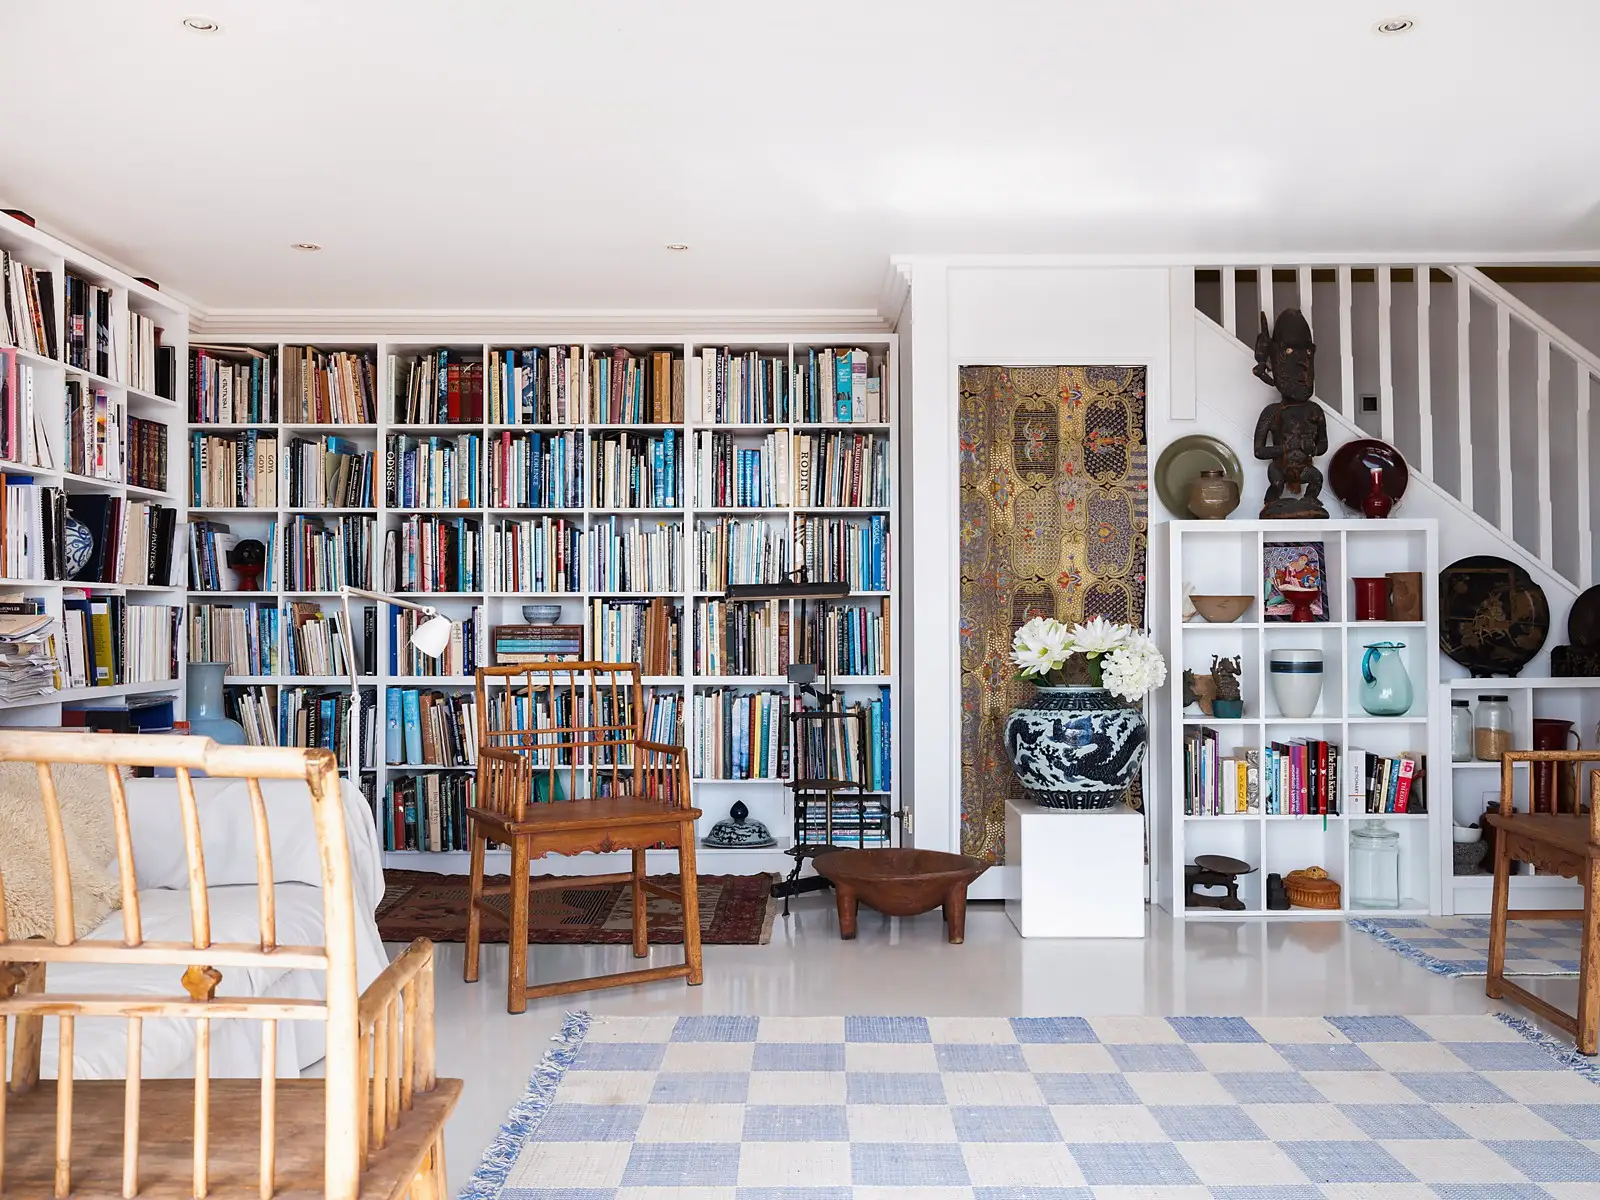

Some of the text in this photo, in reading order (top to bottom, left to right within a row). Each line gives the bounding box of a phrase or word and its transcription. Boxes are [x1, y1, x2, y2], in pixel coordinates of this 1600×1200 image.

[386, 451, 395, 492] ODYSSEY
[532, 451, 540, 487] FLORENCE
[800, 451, 809, 492] RODIN
[149, 533, 159, 569] PAINTERS
[1328, 763, 1336, 781] French
[1328, 781, 1336, 801] Kitchen
[1398, 781, 1407, 808] THEORY
